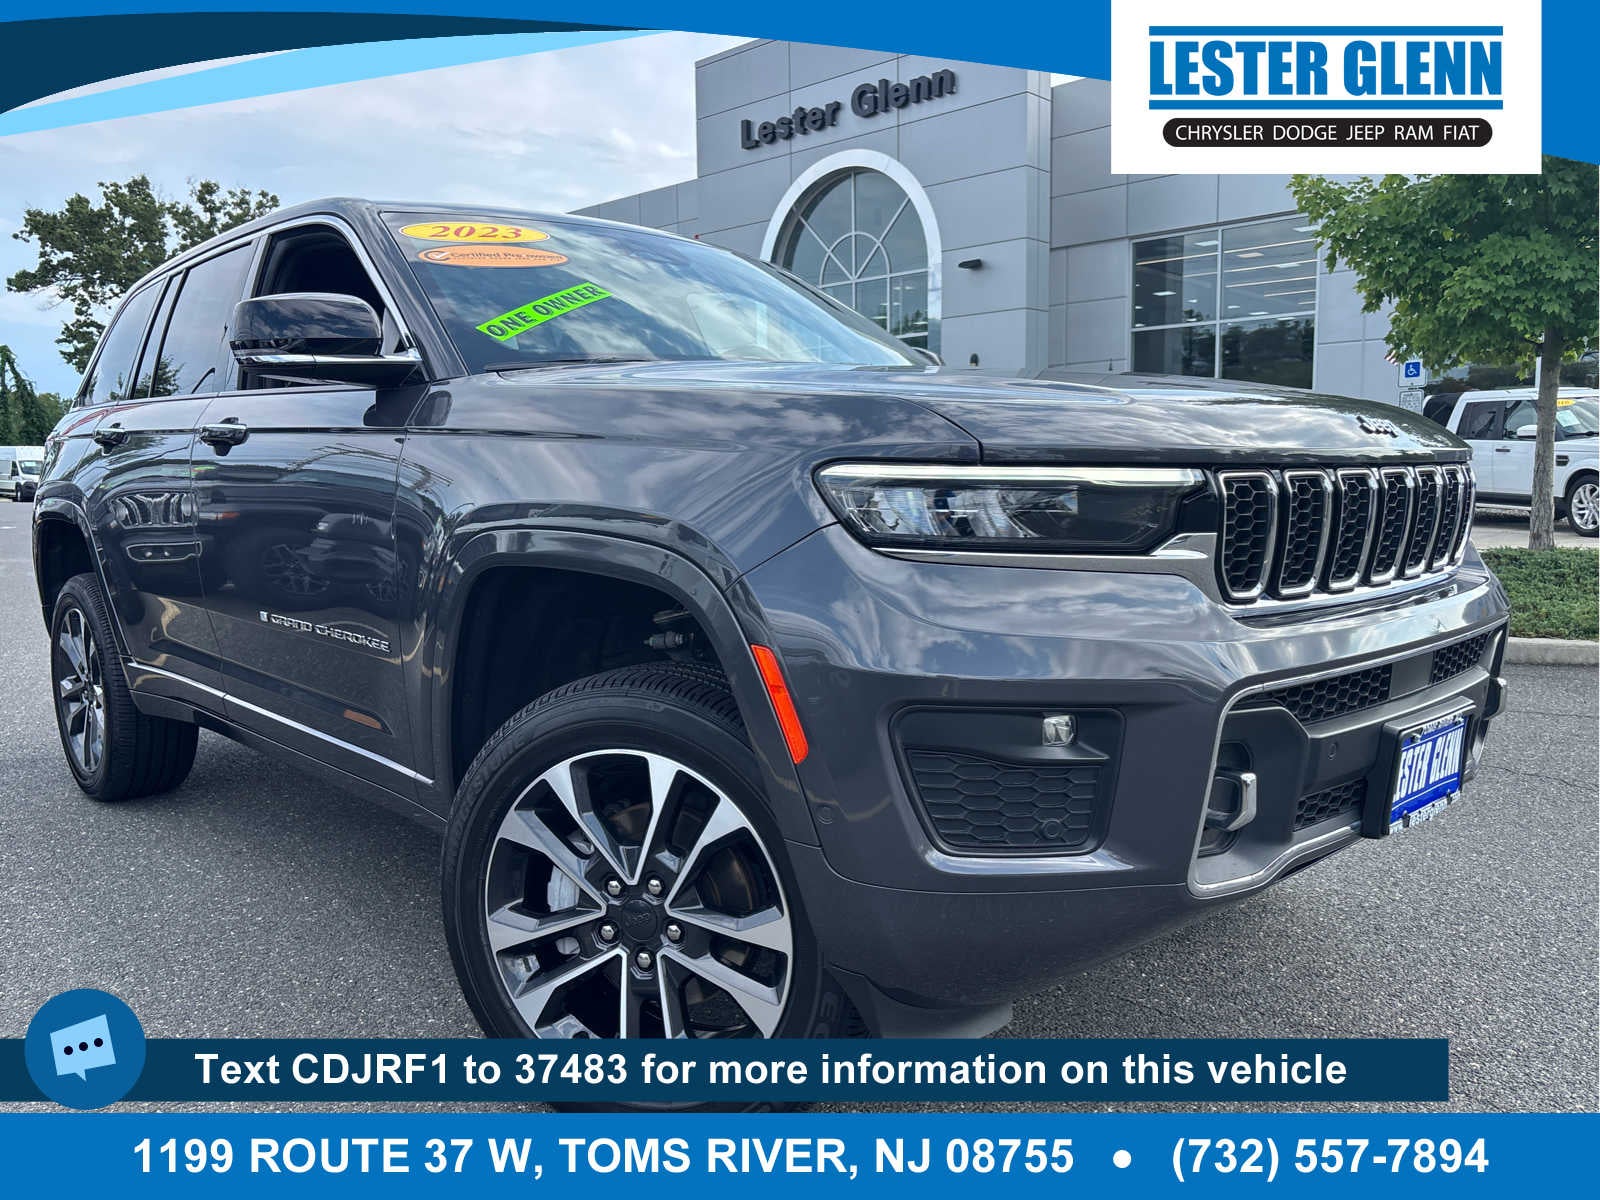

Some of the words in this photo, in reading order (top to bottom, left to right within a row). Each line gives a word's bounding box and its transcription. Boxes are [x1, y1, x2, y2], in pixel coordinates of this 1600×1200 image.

[741, 100, 842, 150] Lester
[851, 69, 957, 118] Glenn
[429, 225, 522, 239] 2023
[486, 312, 535, 338] ONE
[532, 285, 607, 316] OWNER
[270, 613, 313, 632] GRAND
[314, 624, 391, 652] CHEROKEE
[1392, 741, 1433, 803] ESTER
[1429, 727, 1464, 785] GLENN
